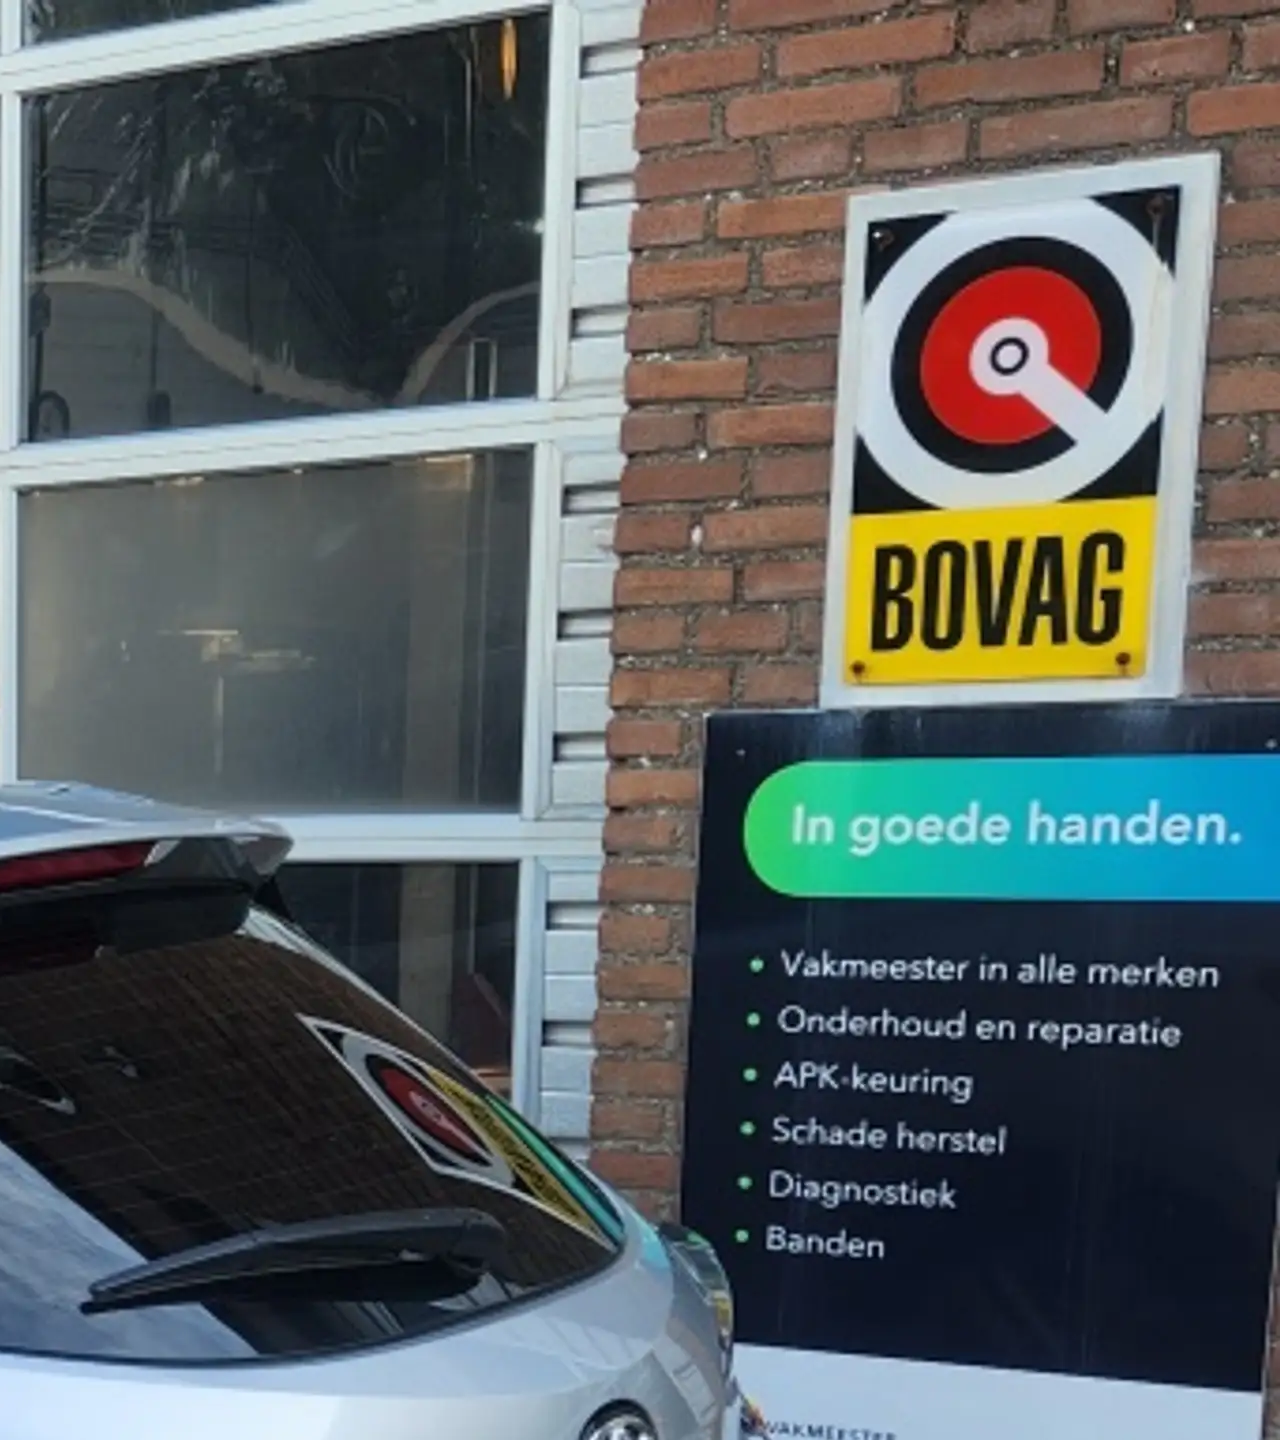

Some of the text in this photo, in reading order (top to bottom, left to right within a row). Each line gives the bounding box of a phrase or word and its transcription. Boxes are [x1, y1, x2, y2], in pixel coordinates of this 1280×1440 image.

[870, 530, 1126, 652] BOVAG
[791, 799, 1242, 856] In goede handen.
[781, 949, 1219, 988] Vakmeester in alle merken
[777, 1005, 1182, 1050] Onderhoud en reparatie
[773, 1061, 974, 1103] APK-keuring
[771, 1116, 1007, 1155] Schade herstel
[768, 1170, 957, 1209] Diagnostiek
[765, 1226, 884, 1258] Banden
